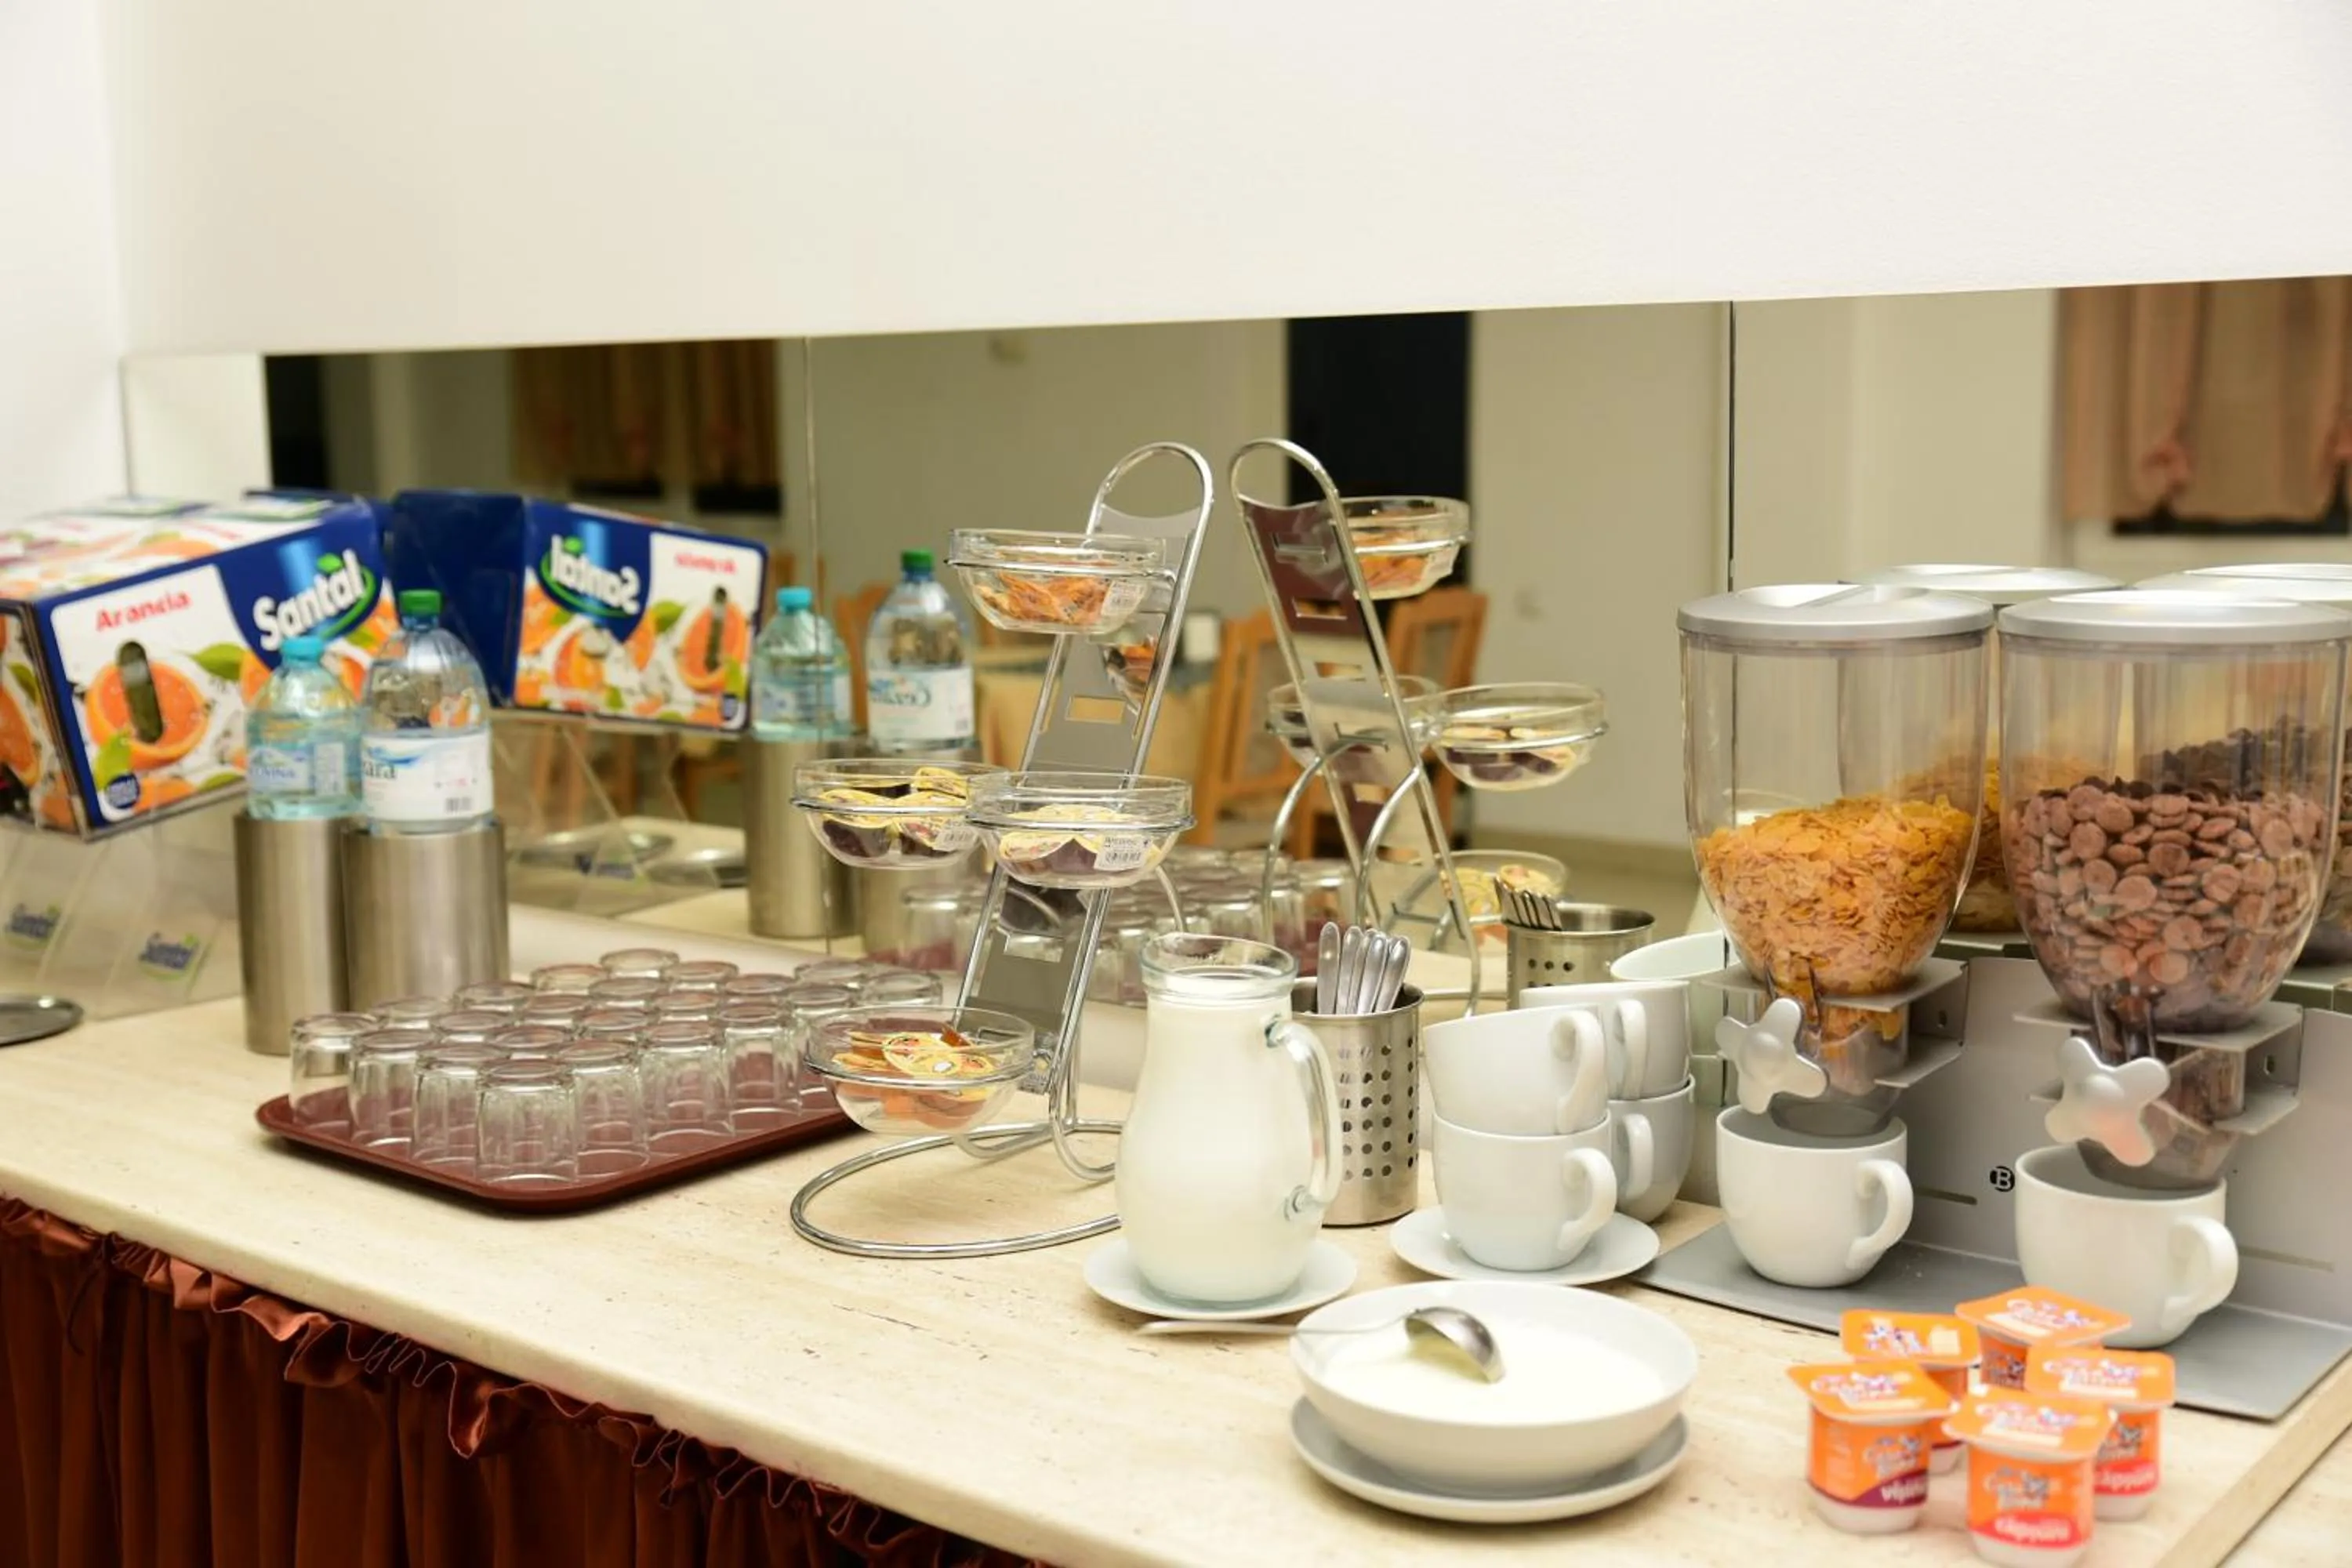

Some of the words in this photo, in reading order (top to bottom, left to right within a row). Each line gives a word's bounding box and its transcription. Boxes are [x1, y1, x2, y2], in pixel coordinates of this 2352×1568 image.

[96, 590, 192, 630] Arancia
[252, 547, 365, 652] Santal
[1991, 1167, 2013, 1191] B
